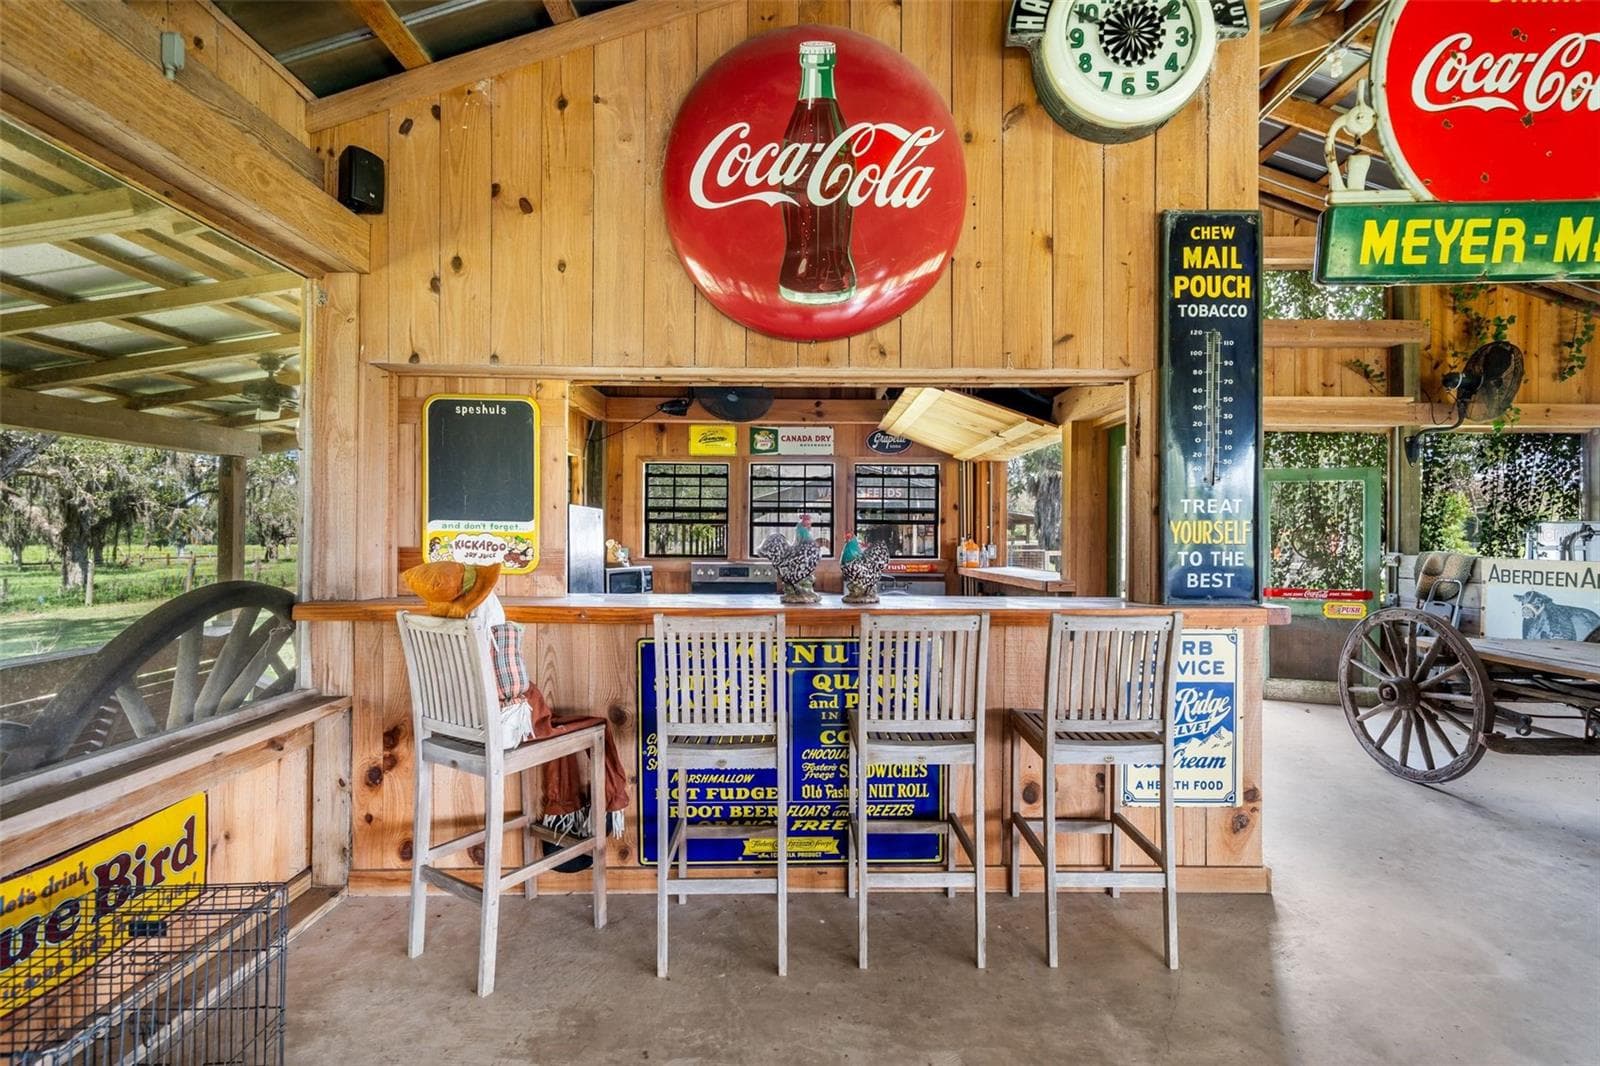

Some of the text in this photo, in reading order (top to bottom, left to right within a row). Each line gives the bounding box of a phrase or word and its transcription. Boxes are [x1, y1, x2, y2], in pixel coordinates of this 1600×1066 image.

[1167, 0, 1181, 20] 2
[1226, 0, 1247, 26] UT
[1069, 28, 1084, 48] 9
[1175, 26, 1189, 47] 3
[1078, 53, 1092, 73] 8
[1164, 52, 1179, 73] 4
[1098, 71, 1113, 91] 7
[1121, 77, 1135, 96] 6
[1146, 71, 1159, 91] 5
[689, 122, 945, 209] Coca-Cola
[1190, 226, 1236, 240] CHEW
[1183, 246, 1243, 269] MAIL
[1174, 275, 1250, 299] POUCH
[1177, 304, 1248, 318] TOBACCO
[455, 403, 507, 416] speshuls
[1180, 499, 1243, 514] TREAT
[490, 522, 529, 531] forget...
[1170, 520, 1251, 545] YOURSELF
[454, 540, 507, 551] KICKAPOO
[1177, 551, 1245, 566] TO THE
[1187, 573, 1235, 588] BEST
[1341, 606, 1361, 614] PUSH
[809, 693, 839, 709] and
[1175, 688, 1233, 723] Ridge
[821, 712, 838, 720] IN
[801, 749, 849, 759] CHOCOLA
[670, 772, 755, 784] MRSHMALLOW
[839, 763, 928, 778] SDWICHES
[656, 787, 779, 800] OT FUDGE
[801, 784, 823, 799] Old
[869, 784, 895, 798] NUT
[897, 783, 930, 798] ROLL
[1136, 781, 1224, 790] A HETH FOOD
[730, 805, 779, 818] BEER
[787, 804, 831, 817] FLOATS
[866, 803, 915, 817] REEZES
[92, 814, 198, 925] Bird
[41, 860, 90, 898] drink
